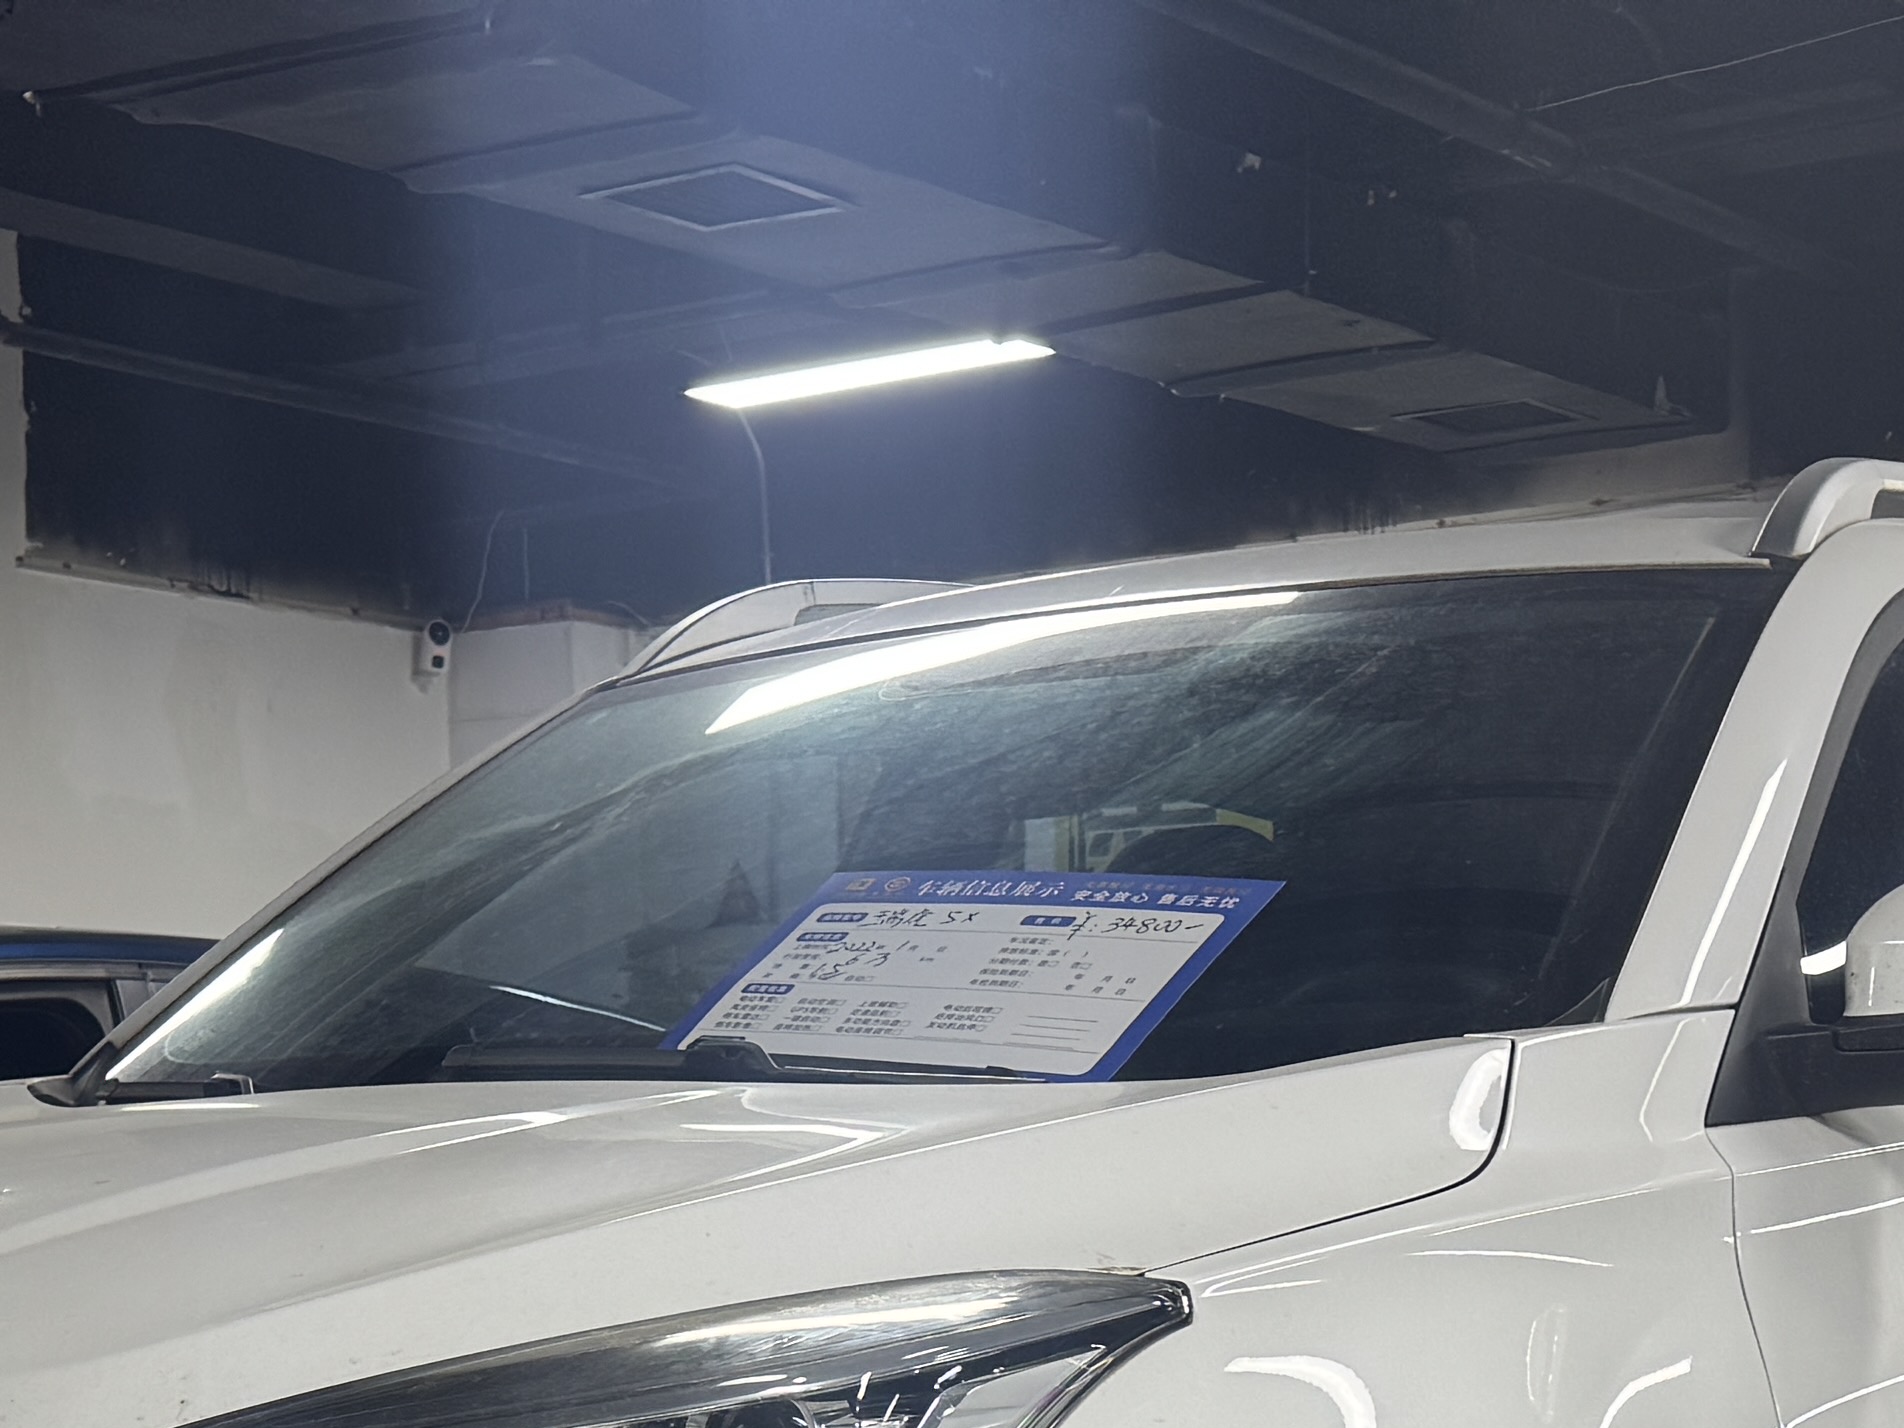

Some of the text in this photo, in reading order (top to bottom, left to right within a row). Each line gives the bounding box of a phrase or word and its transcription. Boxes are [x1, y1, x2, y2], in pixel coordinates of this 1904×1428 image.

[918, 879, 1064, 898] 车辆信息展示
[1071, 889, 1240, 909] 安全放心 售后无忧
